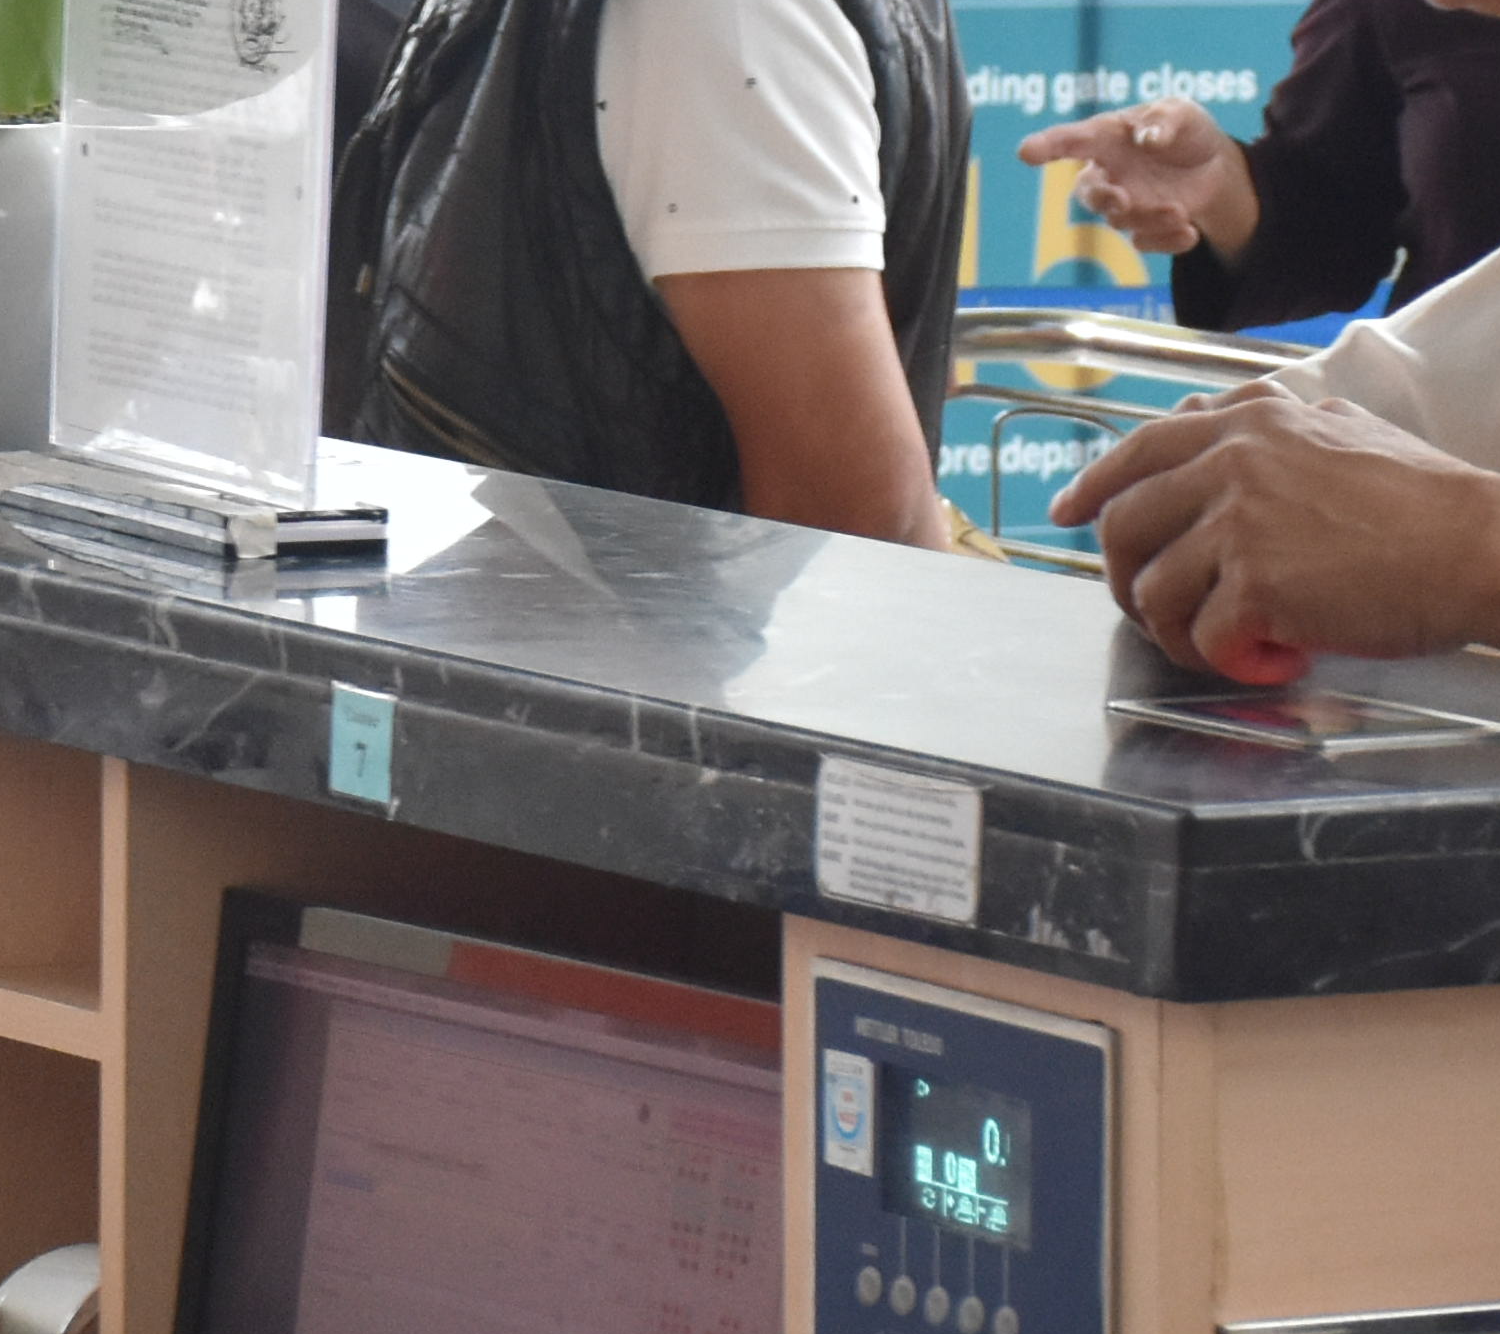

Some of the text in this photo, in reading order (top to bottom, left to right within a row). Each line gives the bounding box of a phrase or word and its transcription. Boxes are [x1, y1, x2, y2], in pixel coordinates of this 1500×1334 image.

[968, 64, 1259, 115] ding gate closes
